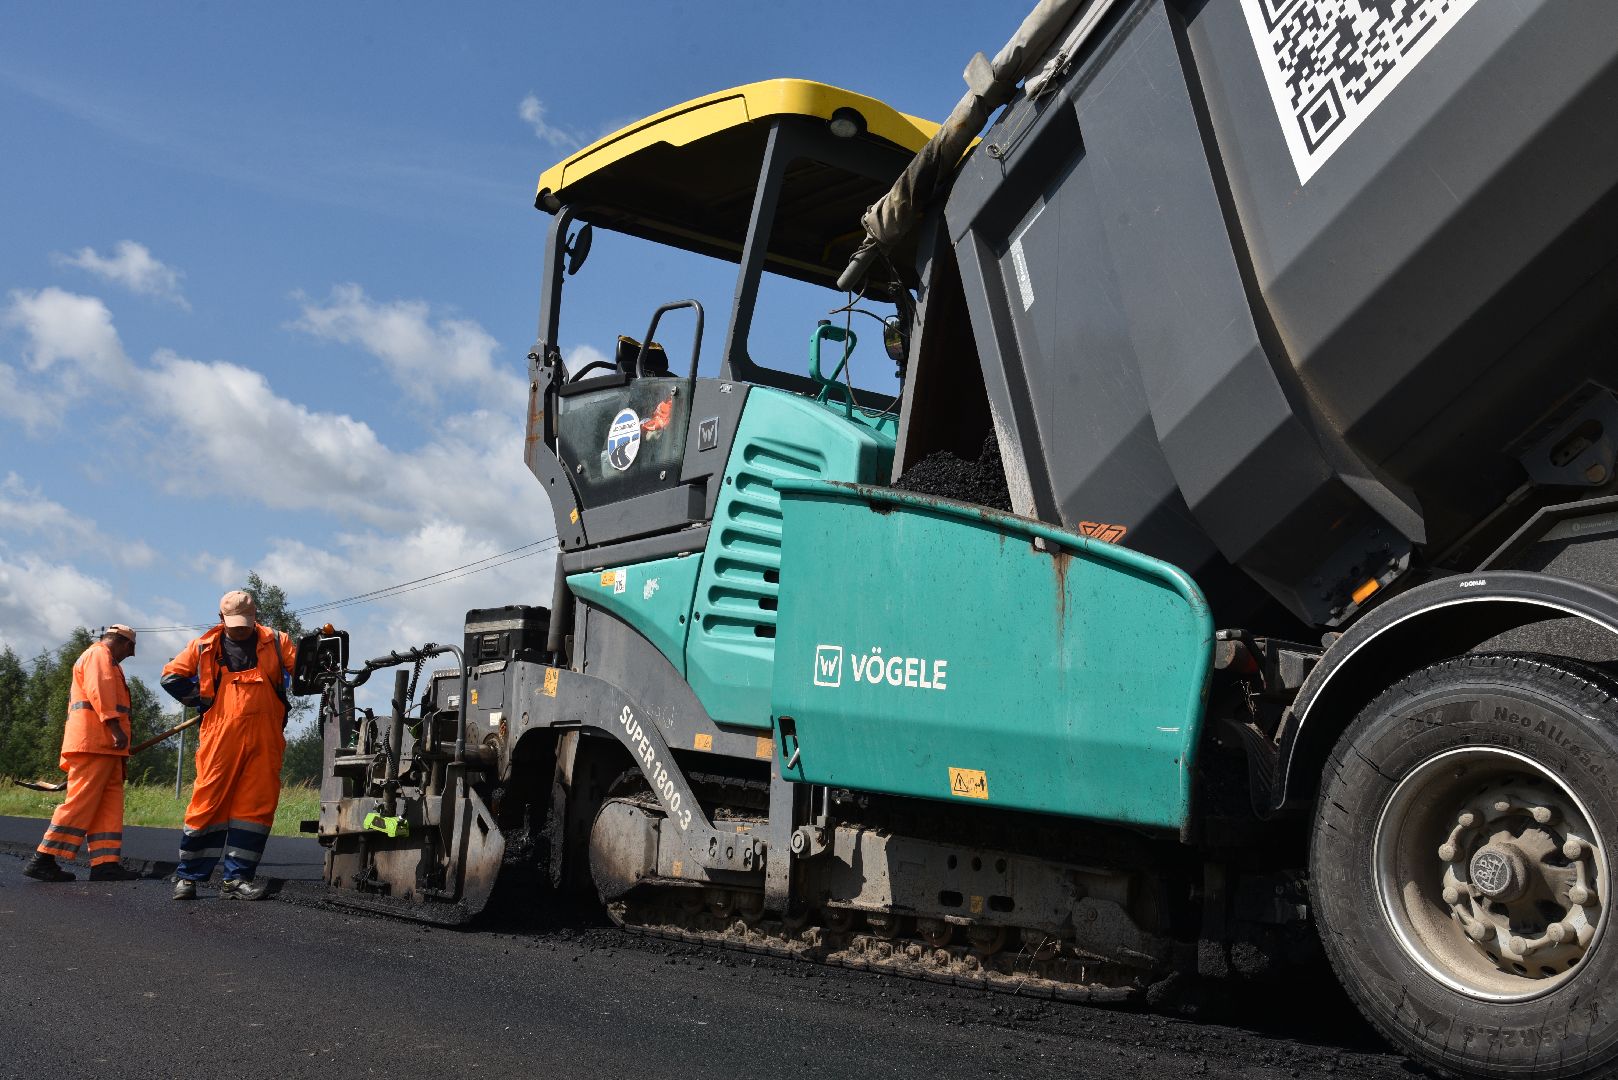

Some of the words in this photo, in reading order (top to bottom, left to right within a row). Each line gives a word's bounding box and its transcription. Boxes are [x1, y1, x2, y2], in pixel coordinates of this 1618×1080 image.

[851, 646, 948, 690] VÖGELE
[619, 705, 656, 769] SUPER
[653, 761, 692, 831] 1800-3
